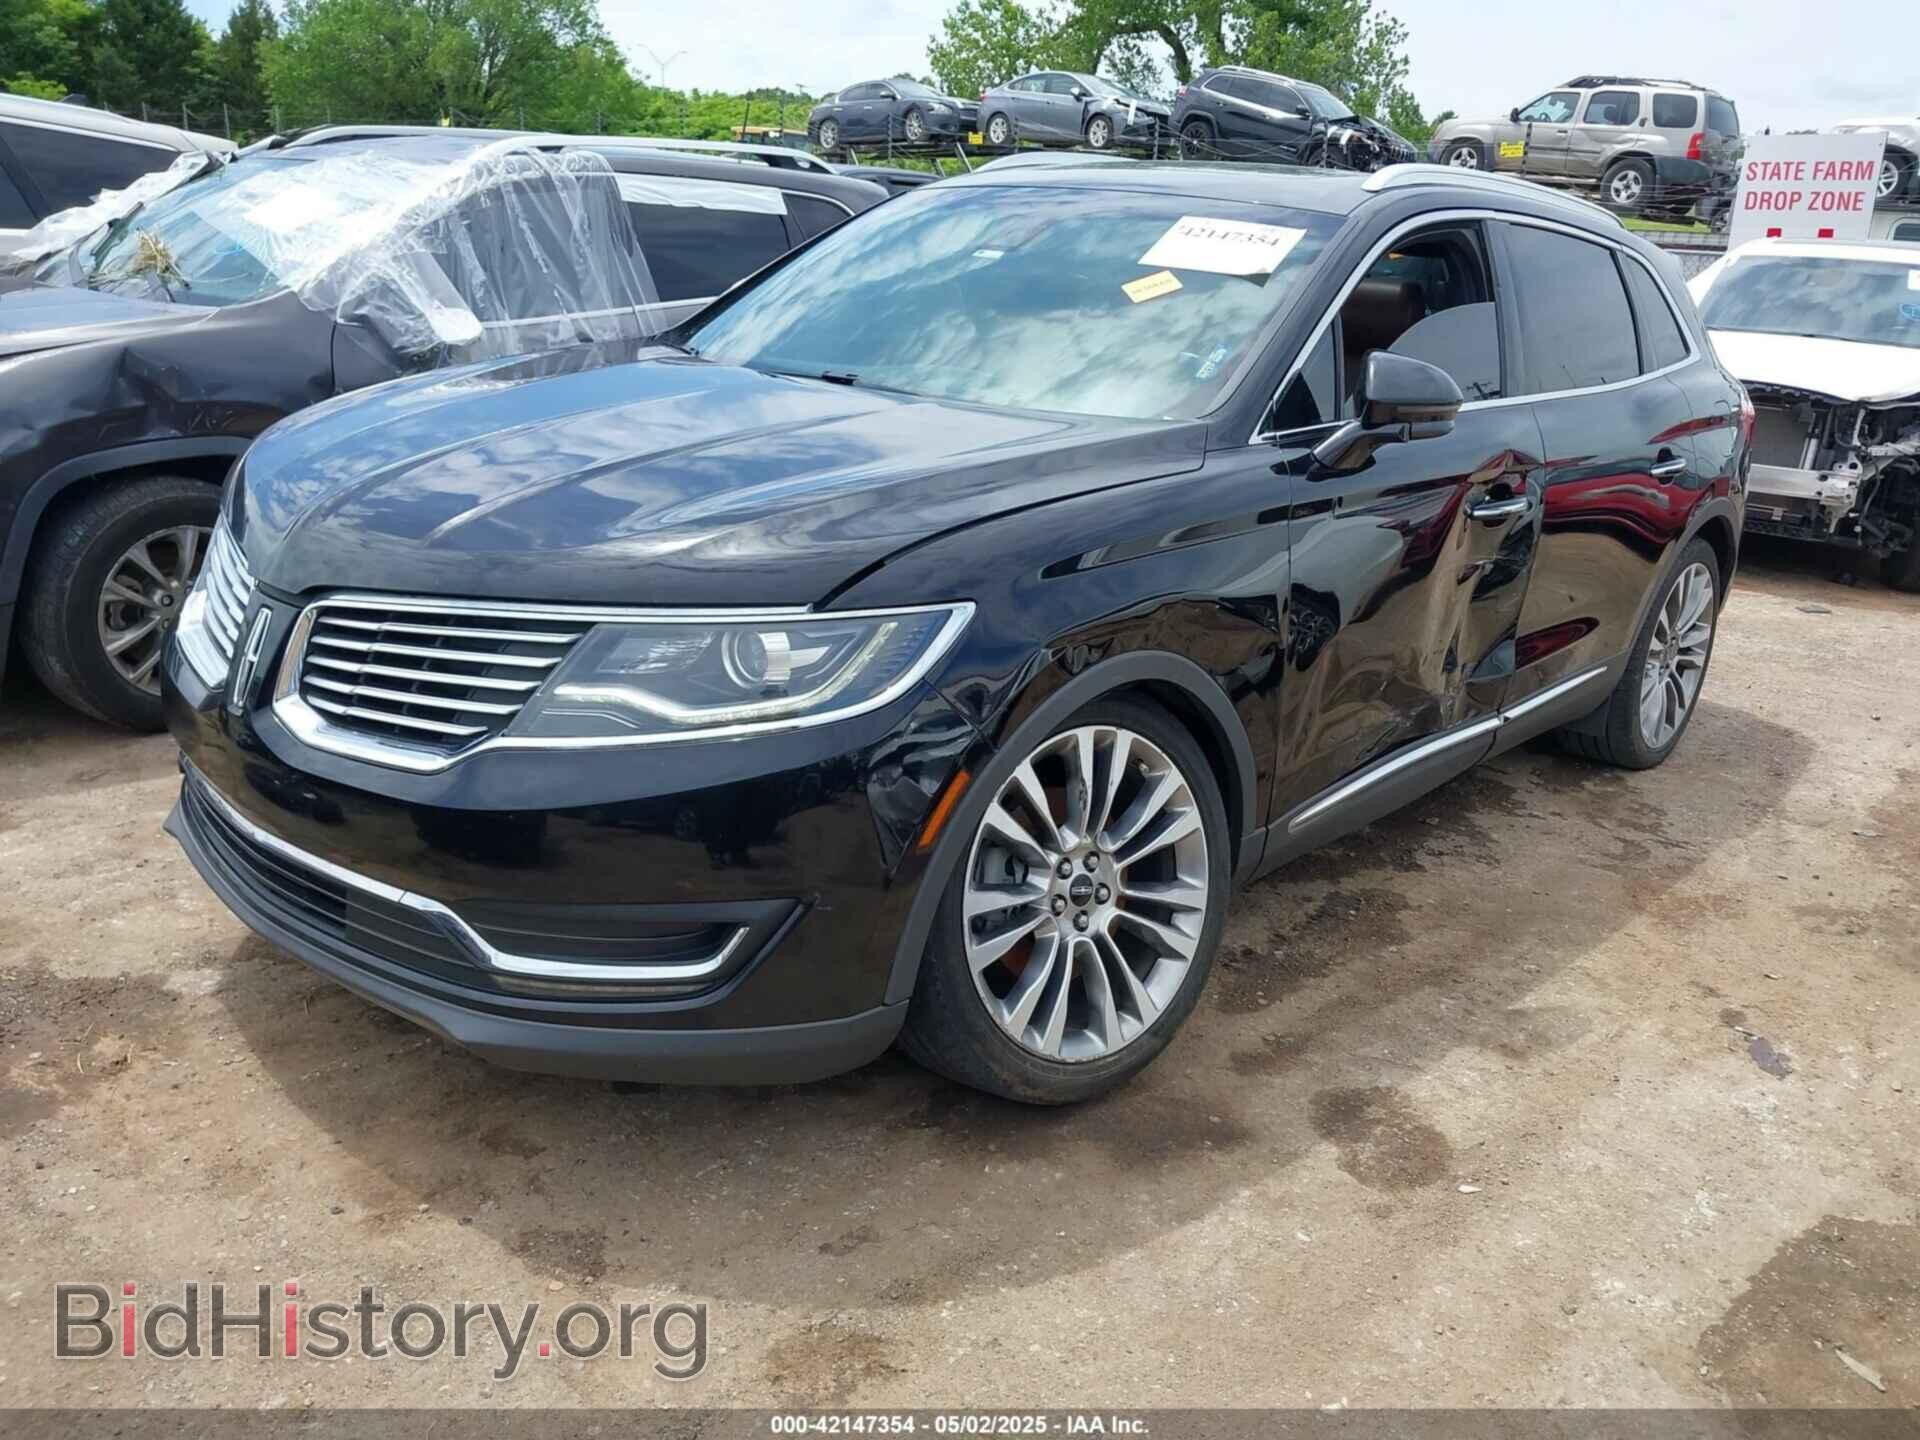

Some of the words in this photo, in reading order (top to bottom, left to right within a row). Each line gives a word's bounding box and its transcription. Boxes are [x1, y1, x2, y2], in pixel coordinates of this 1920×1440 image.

[1746, 161, 1806, 181] STATE
[1812, 160, 1874, 181] FARM
[1744, 191, 1802, 210] DROP
[1808, 191, 1865, 211] ZONE
